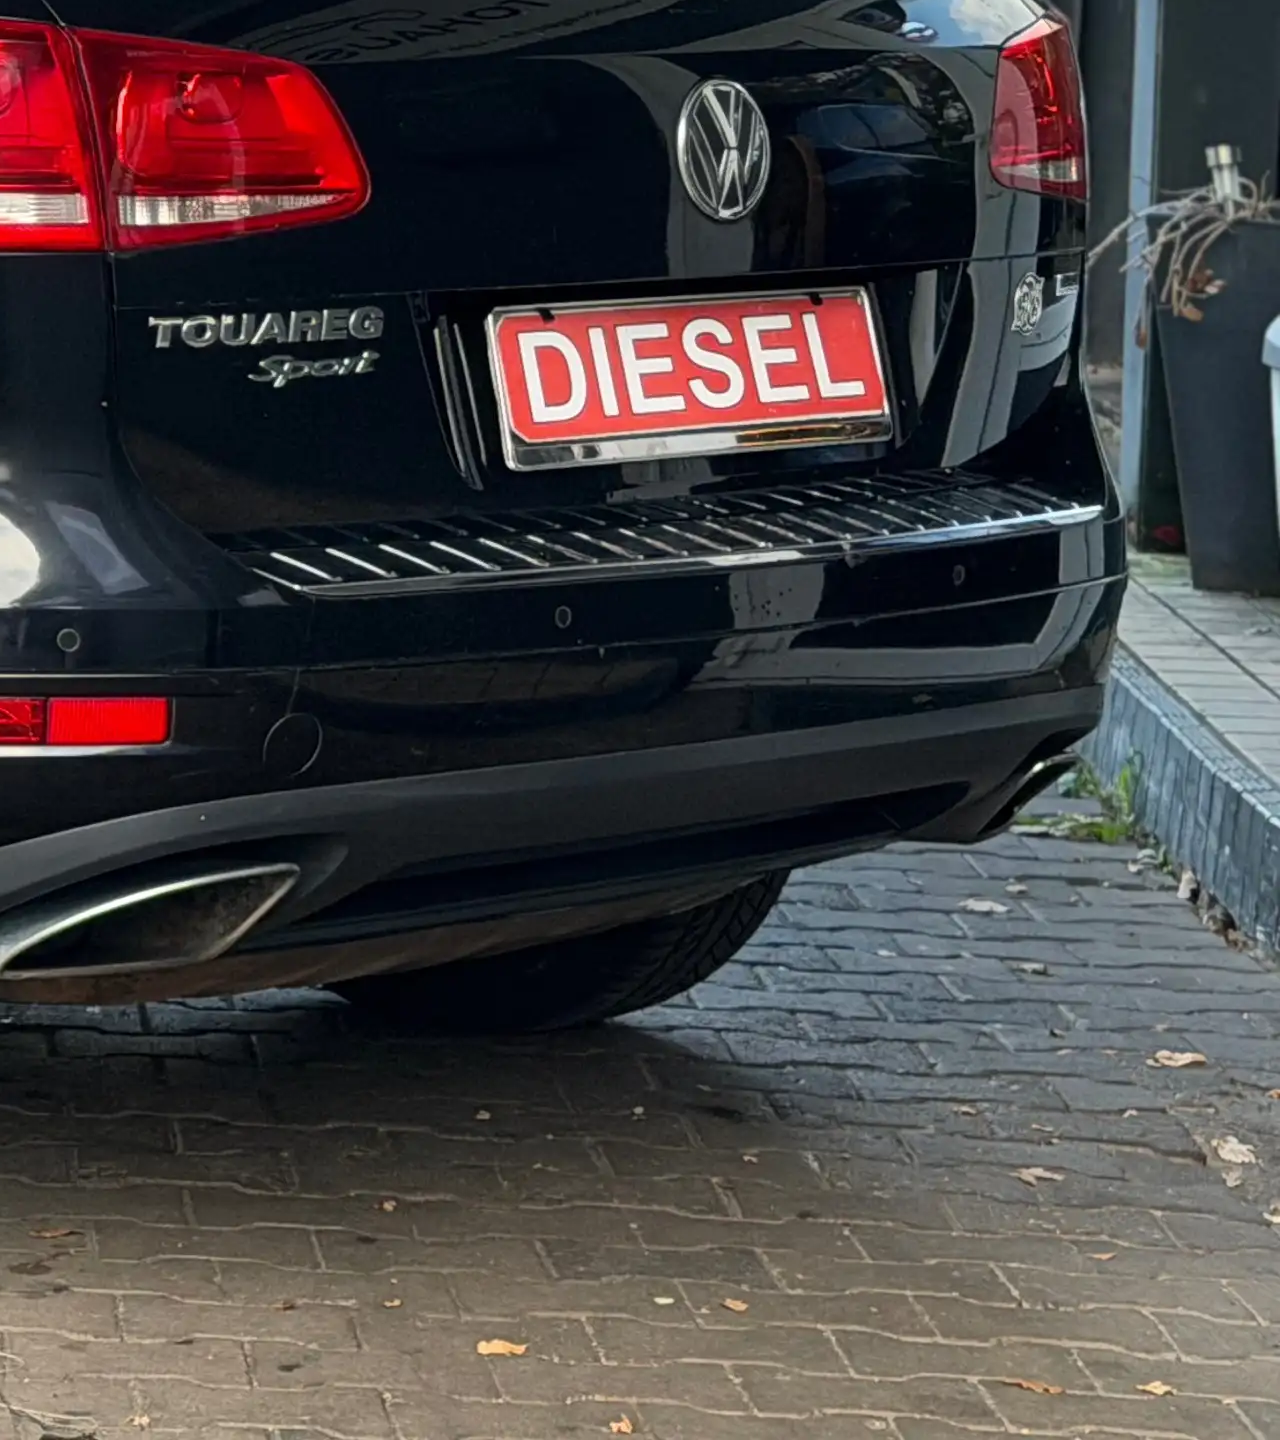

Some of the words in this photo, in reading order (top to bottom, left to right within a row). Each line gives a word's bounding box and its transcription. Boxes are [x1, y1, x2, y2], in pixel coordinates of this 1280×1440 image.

[148, 306, 384, 348] TOUAREG
[247, 350, 381, 388] Sport
[516, 312, 866, 424] DIESEL
